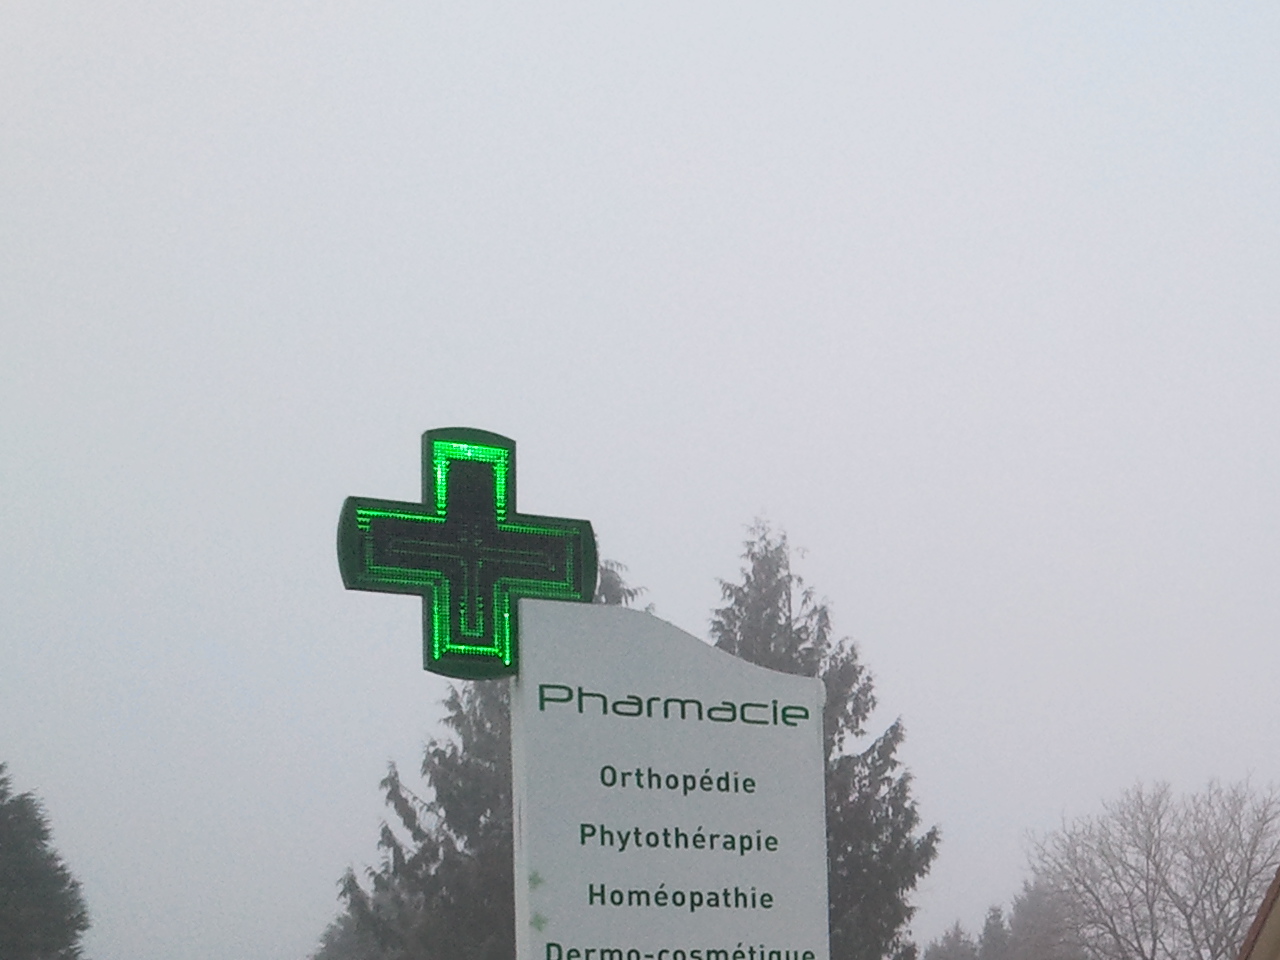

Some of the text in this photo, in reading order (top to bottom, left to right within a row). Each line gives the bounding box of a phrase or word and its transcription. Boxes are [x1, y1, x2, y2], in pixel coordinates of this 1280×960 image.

[538, 683, 810, 727] Pharmacie
[600, 765, 757, 796] Orthopédie
[579, 823, 779, 856] Phytothérapie
[588, 883, 775, 913] Homéopathie
